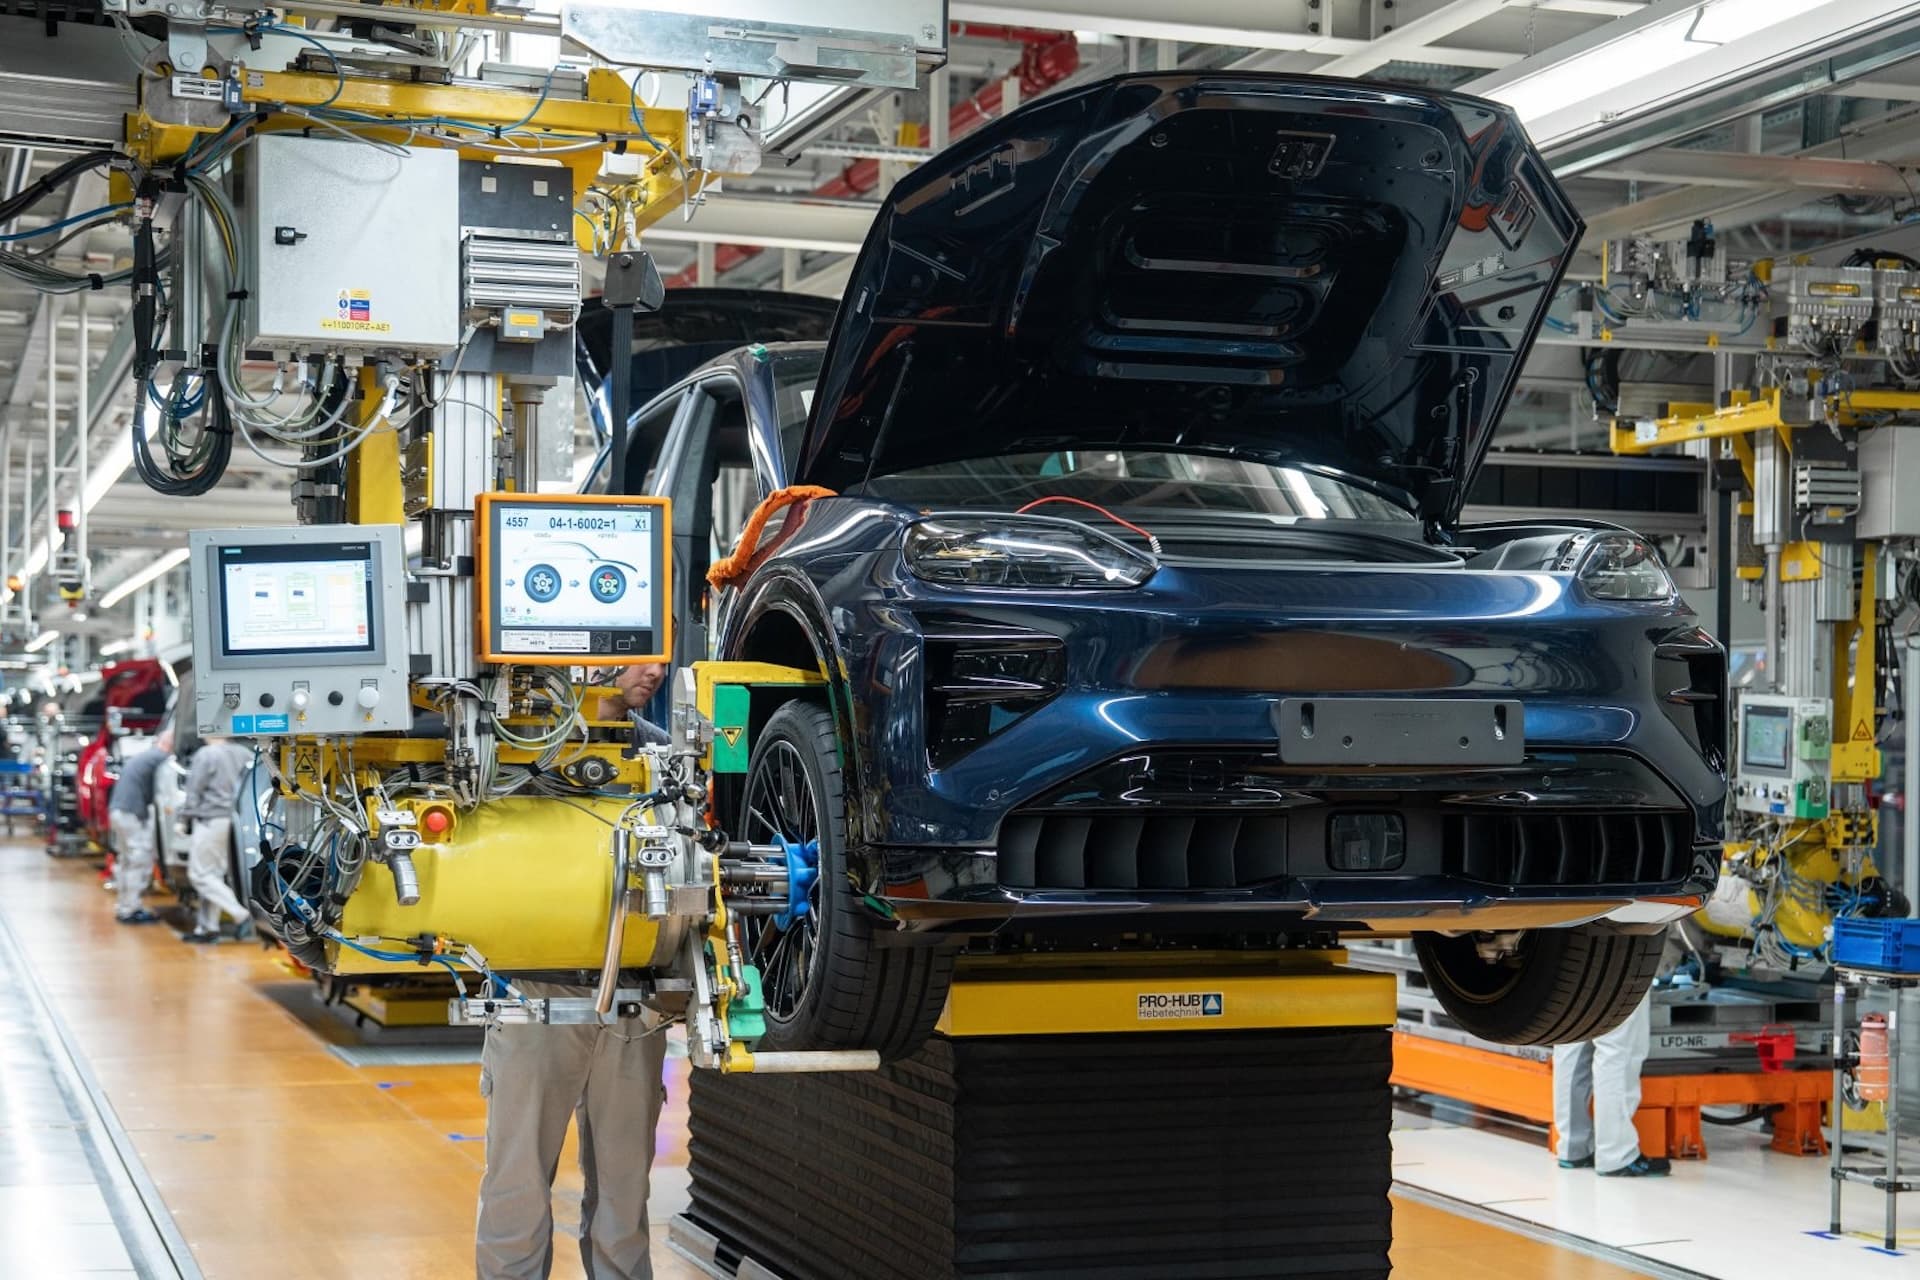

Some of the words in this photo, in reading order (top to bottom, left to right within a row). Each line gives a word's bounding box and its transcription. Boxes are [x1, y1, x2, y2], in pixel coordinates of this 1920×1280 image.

[506, 517, 529, 527] 4557
[549, 517, 617, 530] 04-1-6002=1
[634, 518, 647, 529] X1
[1139, 994, 1201, 1008] PRO-HUB
[1139, 1008, 1201, 1018] Hebetechnik
